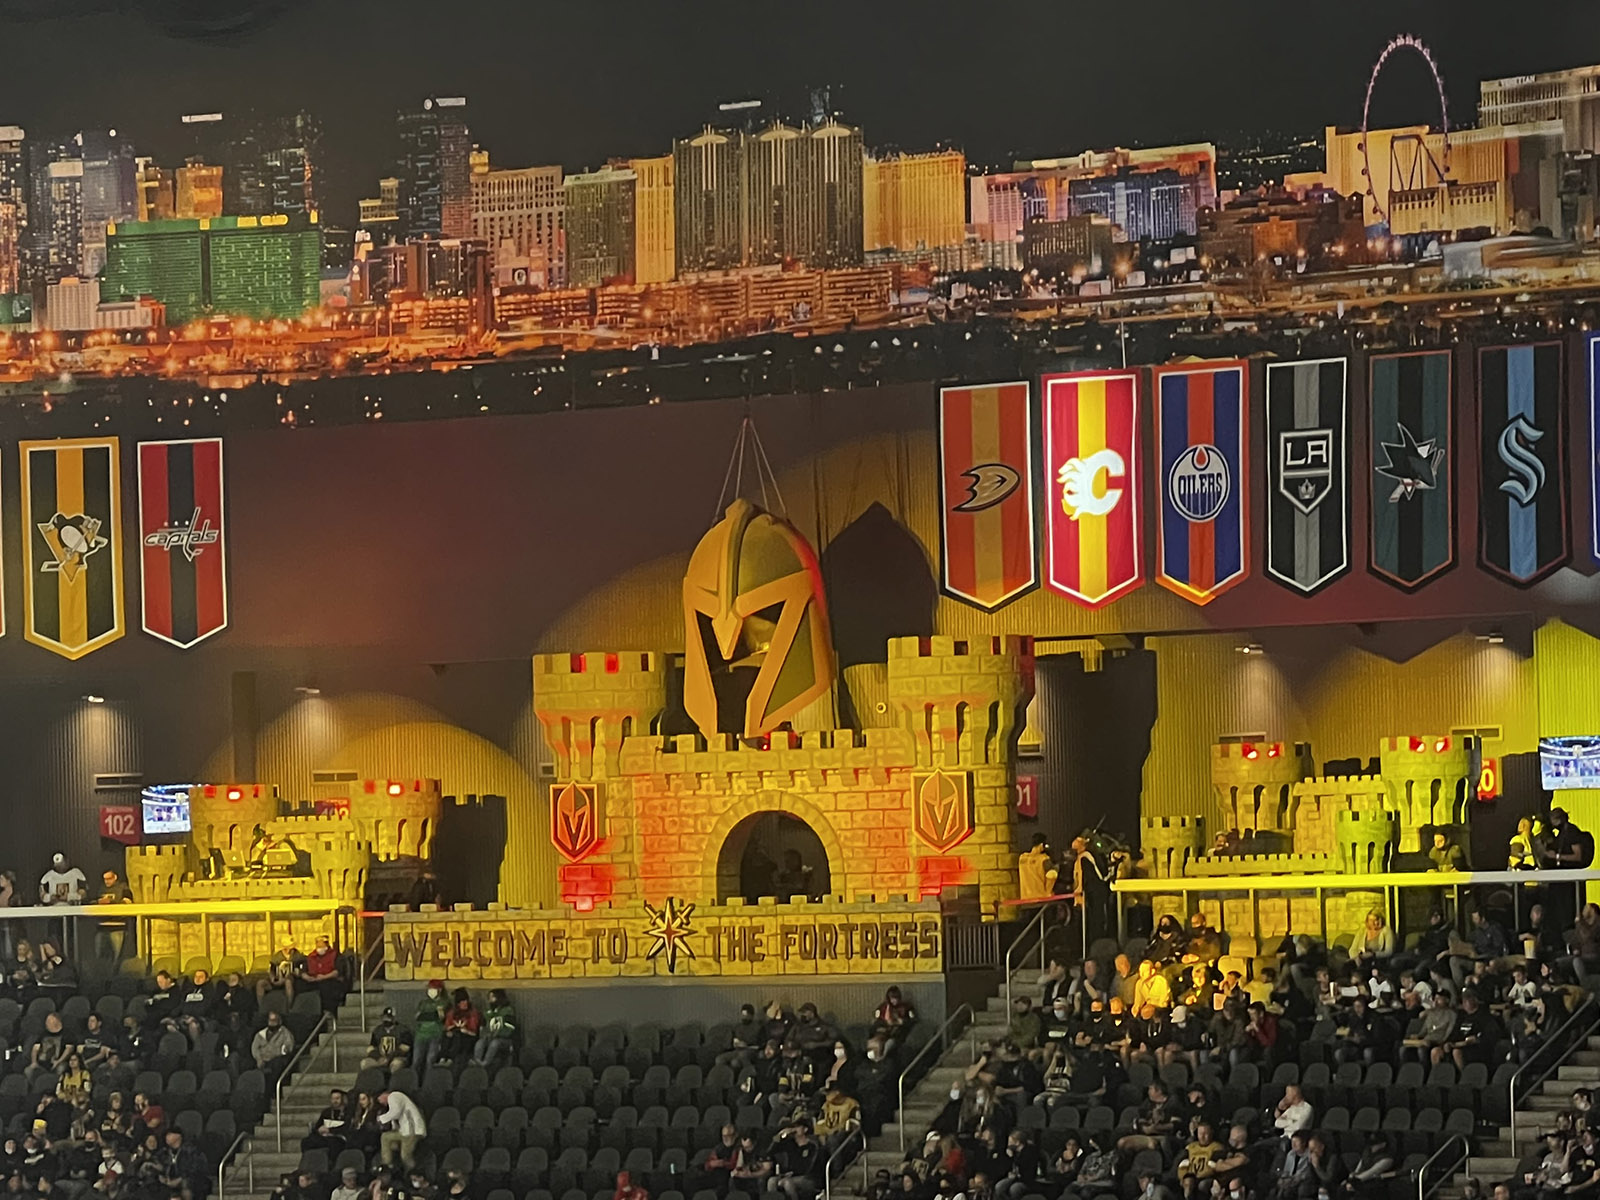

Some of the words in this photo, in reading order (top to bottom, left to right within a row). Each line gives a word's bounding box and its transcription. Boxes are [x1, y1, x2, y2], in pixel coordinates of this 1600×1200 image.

[1286, 440, 1327, 466] LA
[1178, 472, 1223, 500] OILERS
[104, 814, 135, 836] 102
[391, 929, 568, 968] WELCOME
[585, 927, 628, 964] TO
[706, 925, 765, 962] THE
[779, 921, 941, 961] FORTRESS
